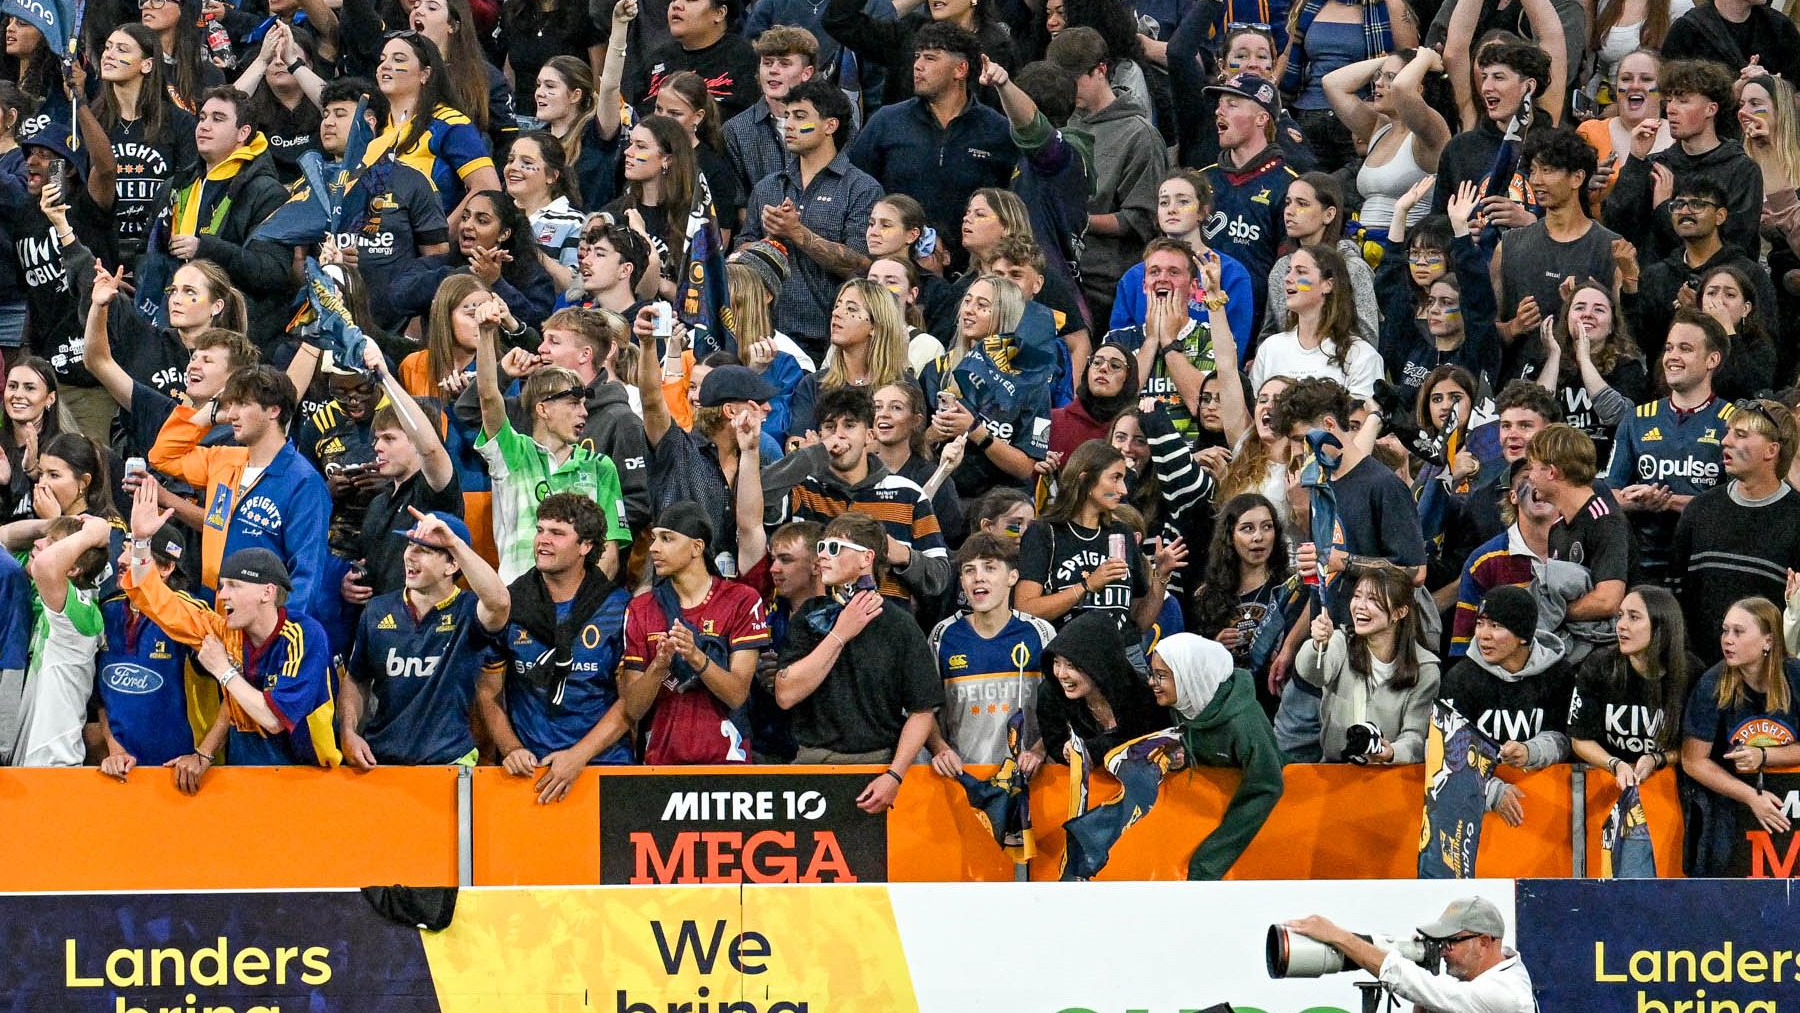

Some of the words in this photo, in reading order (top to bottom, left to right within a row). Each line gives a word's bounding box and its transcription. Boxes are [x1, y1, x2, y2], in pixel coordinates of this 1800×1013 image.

[1228, 215, 1261, 241] sbs
[368, 247, 394, 256] energy
[1233, 237, 1251, 246] BANK
[1659, 455, 1720, 480] pulse
[1691, 476, 1719, 486] energy
[240, 496, 282, 529] SPEIGHT'S
[1093, 586, 1131, 608] EDIN
[385, 647, 442, 678] bnz
[110, 665, 149, 690] Ford
[951, 680, 1033, 704] SPEIGHT'S
[1605, 703, 1665, 737] KIW
[1736, 720, 1792, 746] SPEIGHT'S
[661, 791, 774, 821] MITRE
[783, 790, 827, 821] 10
[629, 830, 859, 883] MEGA
[650, 919, 772, 975] We
[65, 936, 332, 988] Landers
